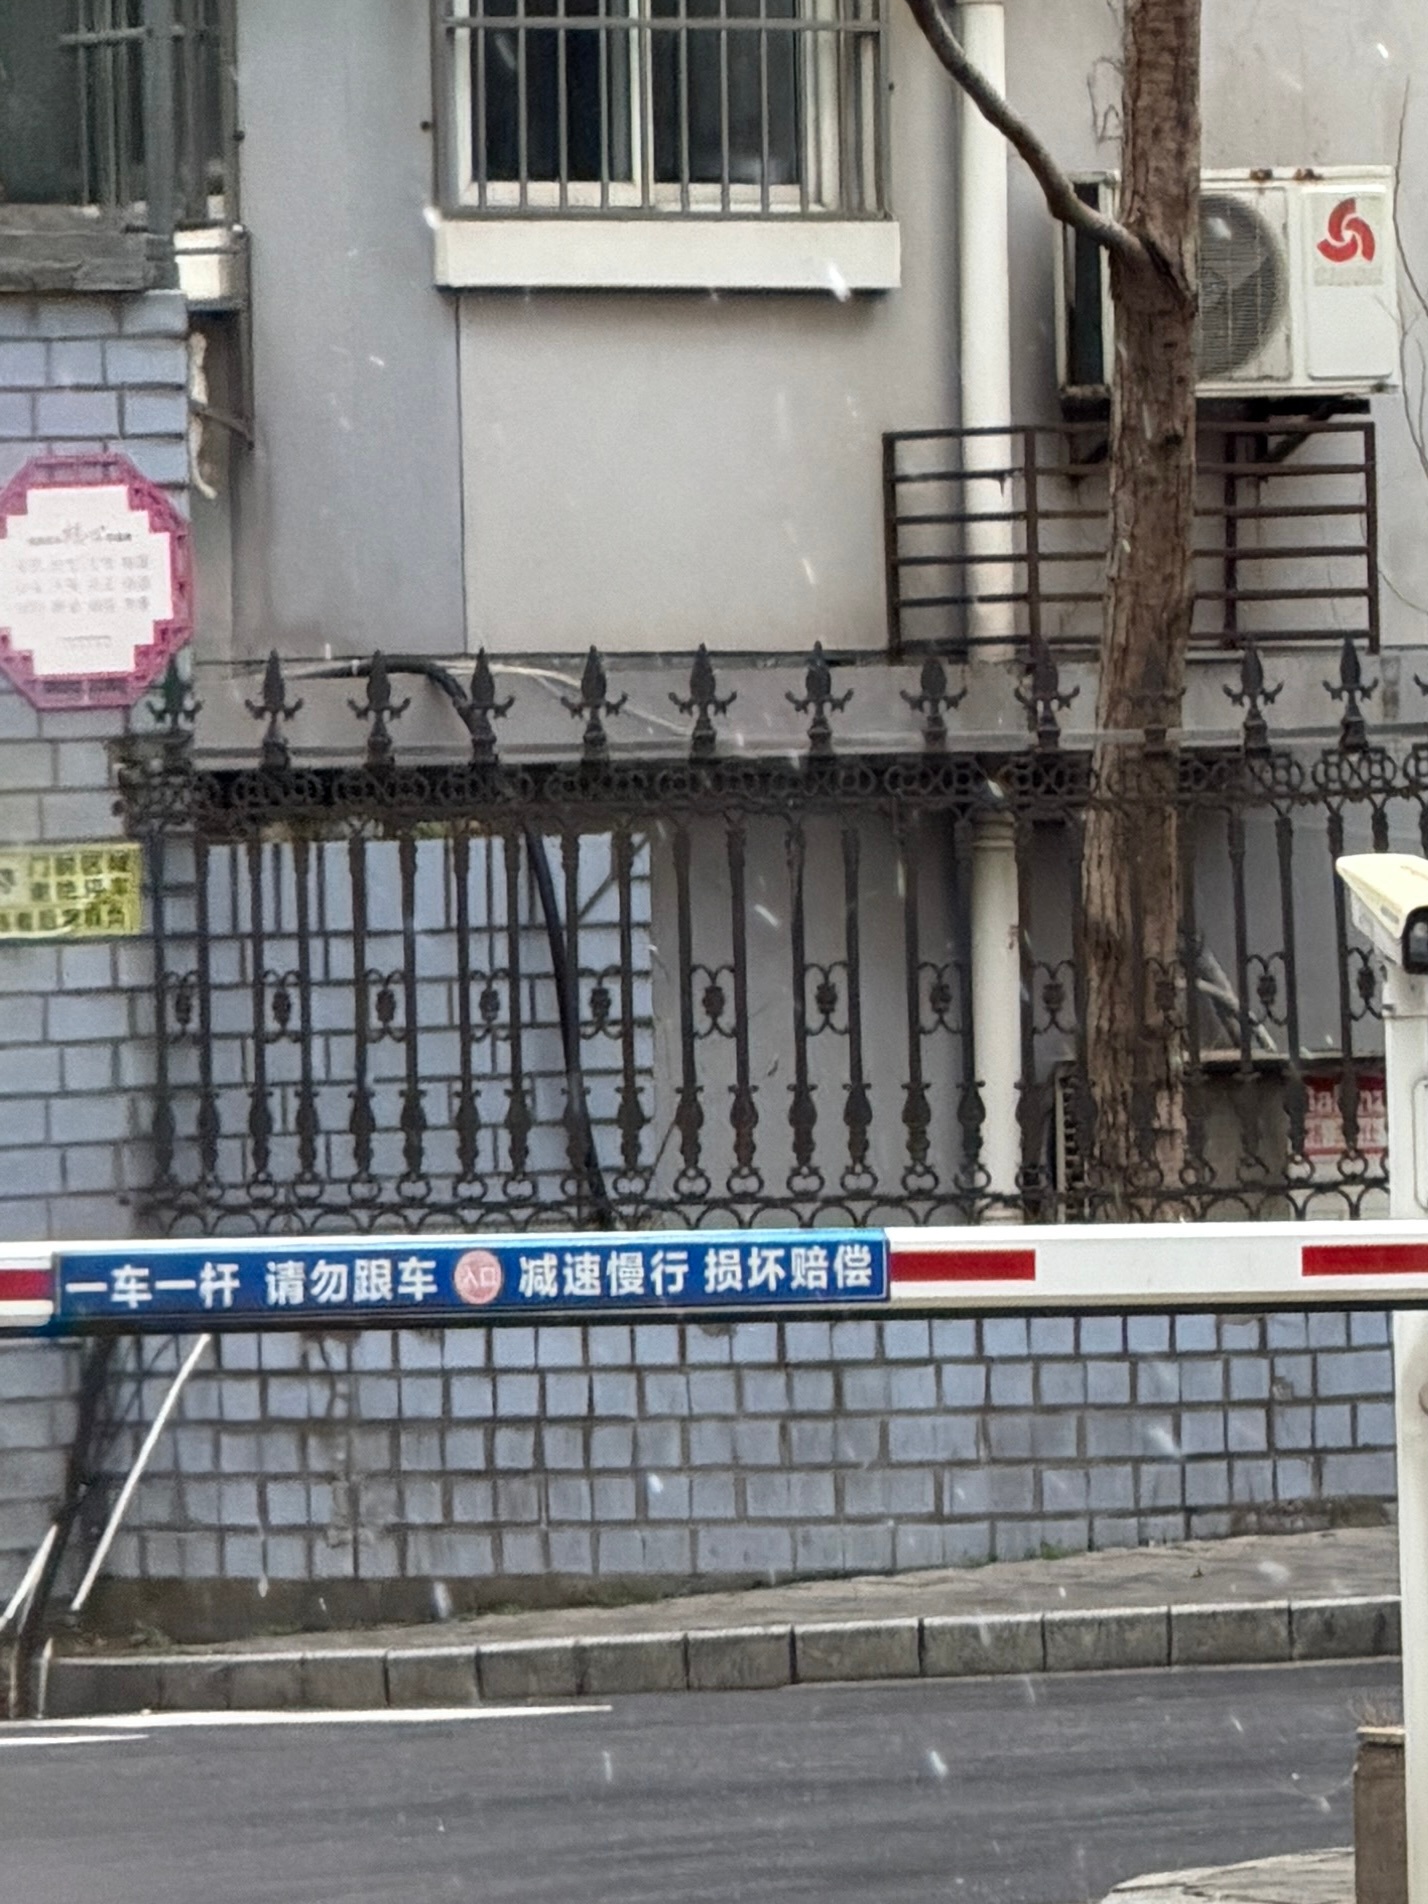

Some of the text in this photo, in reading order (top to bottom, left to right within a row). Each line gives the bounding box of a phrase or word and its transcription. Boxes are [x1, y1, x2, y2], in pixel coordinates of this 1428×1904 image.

[65, 1261, 240, 1309] 一车一杆
[264, 1256, 438, 1306] 请勿跟车
[518, 1249, 690, 1298] 减速慢行
[704, 1244, 872, 1294] 损坏赔偿
